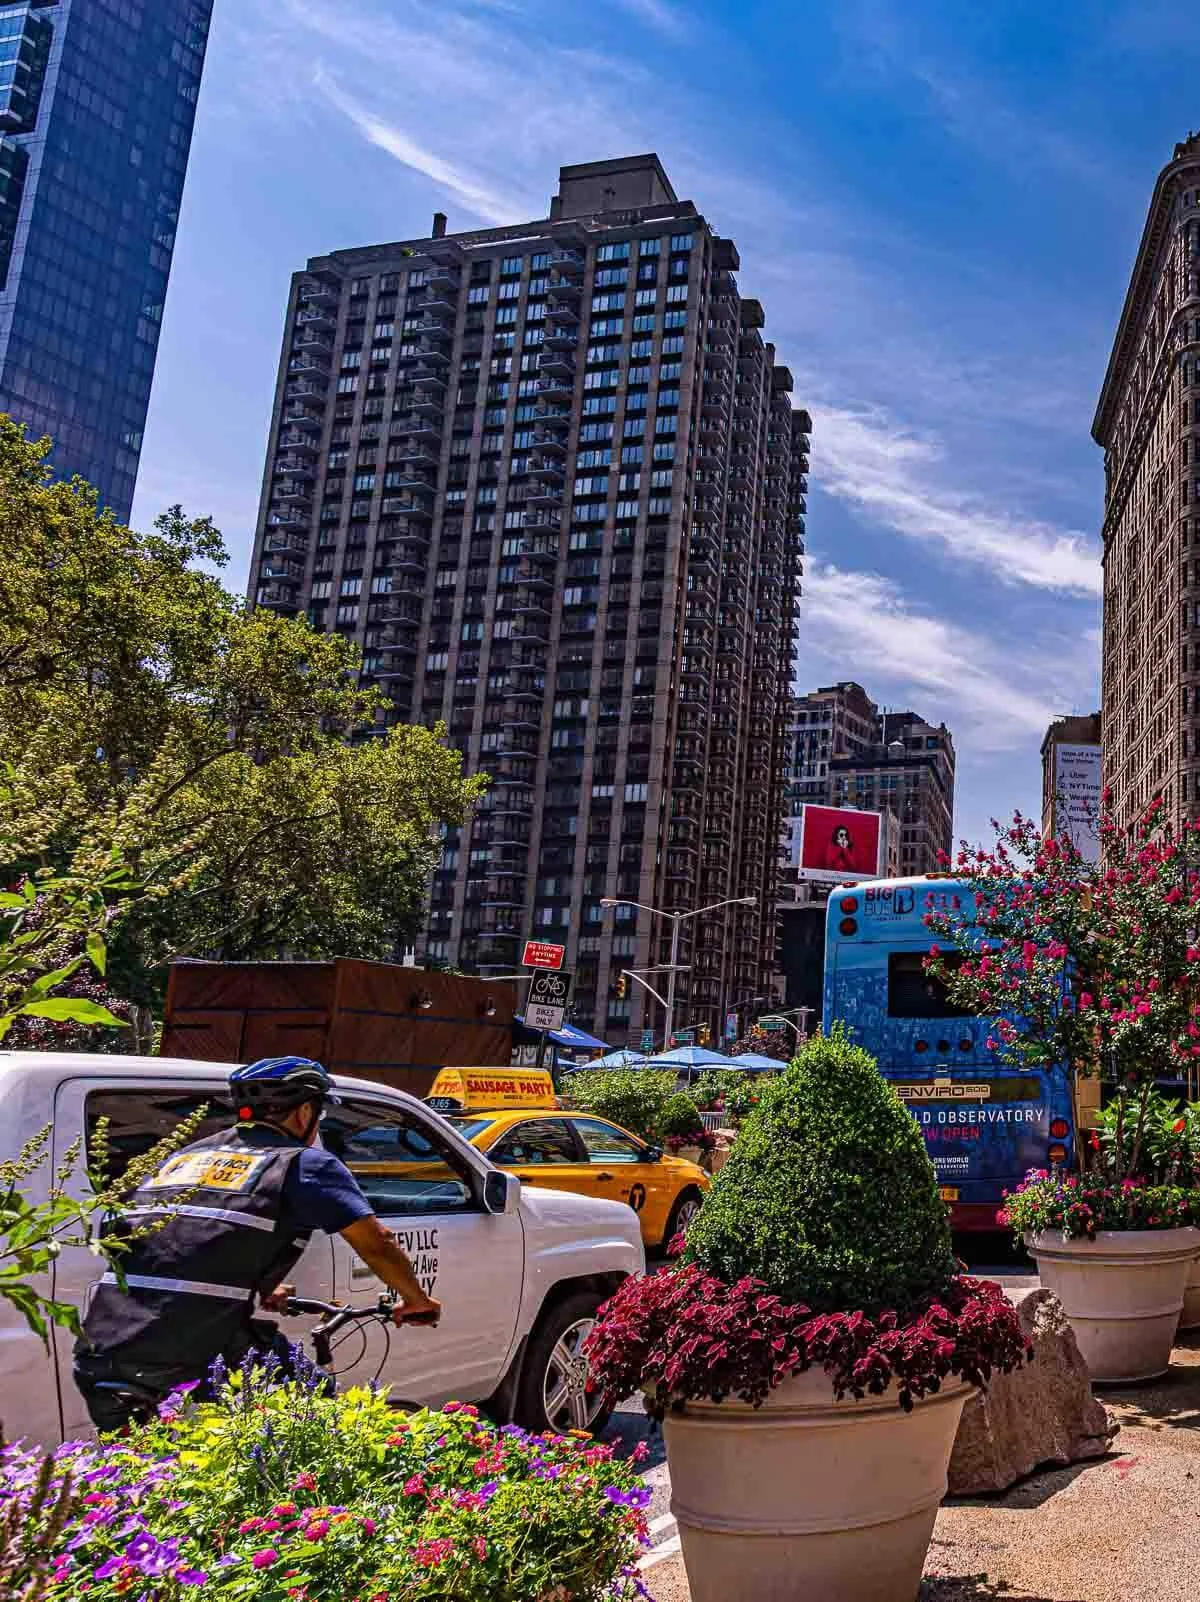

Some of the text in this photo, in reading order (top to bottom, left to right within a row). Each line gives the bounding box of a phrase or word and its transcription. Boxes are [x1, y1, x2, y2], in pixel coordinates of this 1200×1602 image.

[865, 887, 892, 901] BIG
[531, 950, 556, 959] ANYTIME
[538, 944, 562, 953] STOPPING
[531, 994, 565, 1006] BIKE LANE
[536, 1007, 556, 1017] BIKES
[535, 1017, 553, 1026] ONLY
[466, 1079, 515, 1094] SAUSAGE
[519, 1081, 552, 1096] PARTY
[938, 1109, 1044, 1124] OBSERVATORY
[943, 1126, 981, 1141] OPEN
[416, 1229, 439, 1251] LLC
[420, 1254, 438, 1275] Ave
